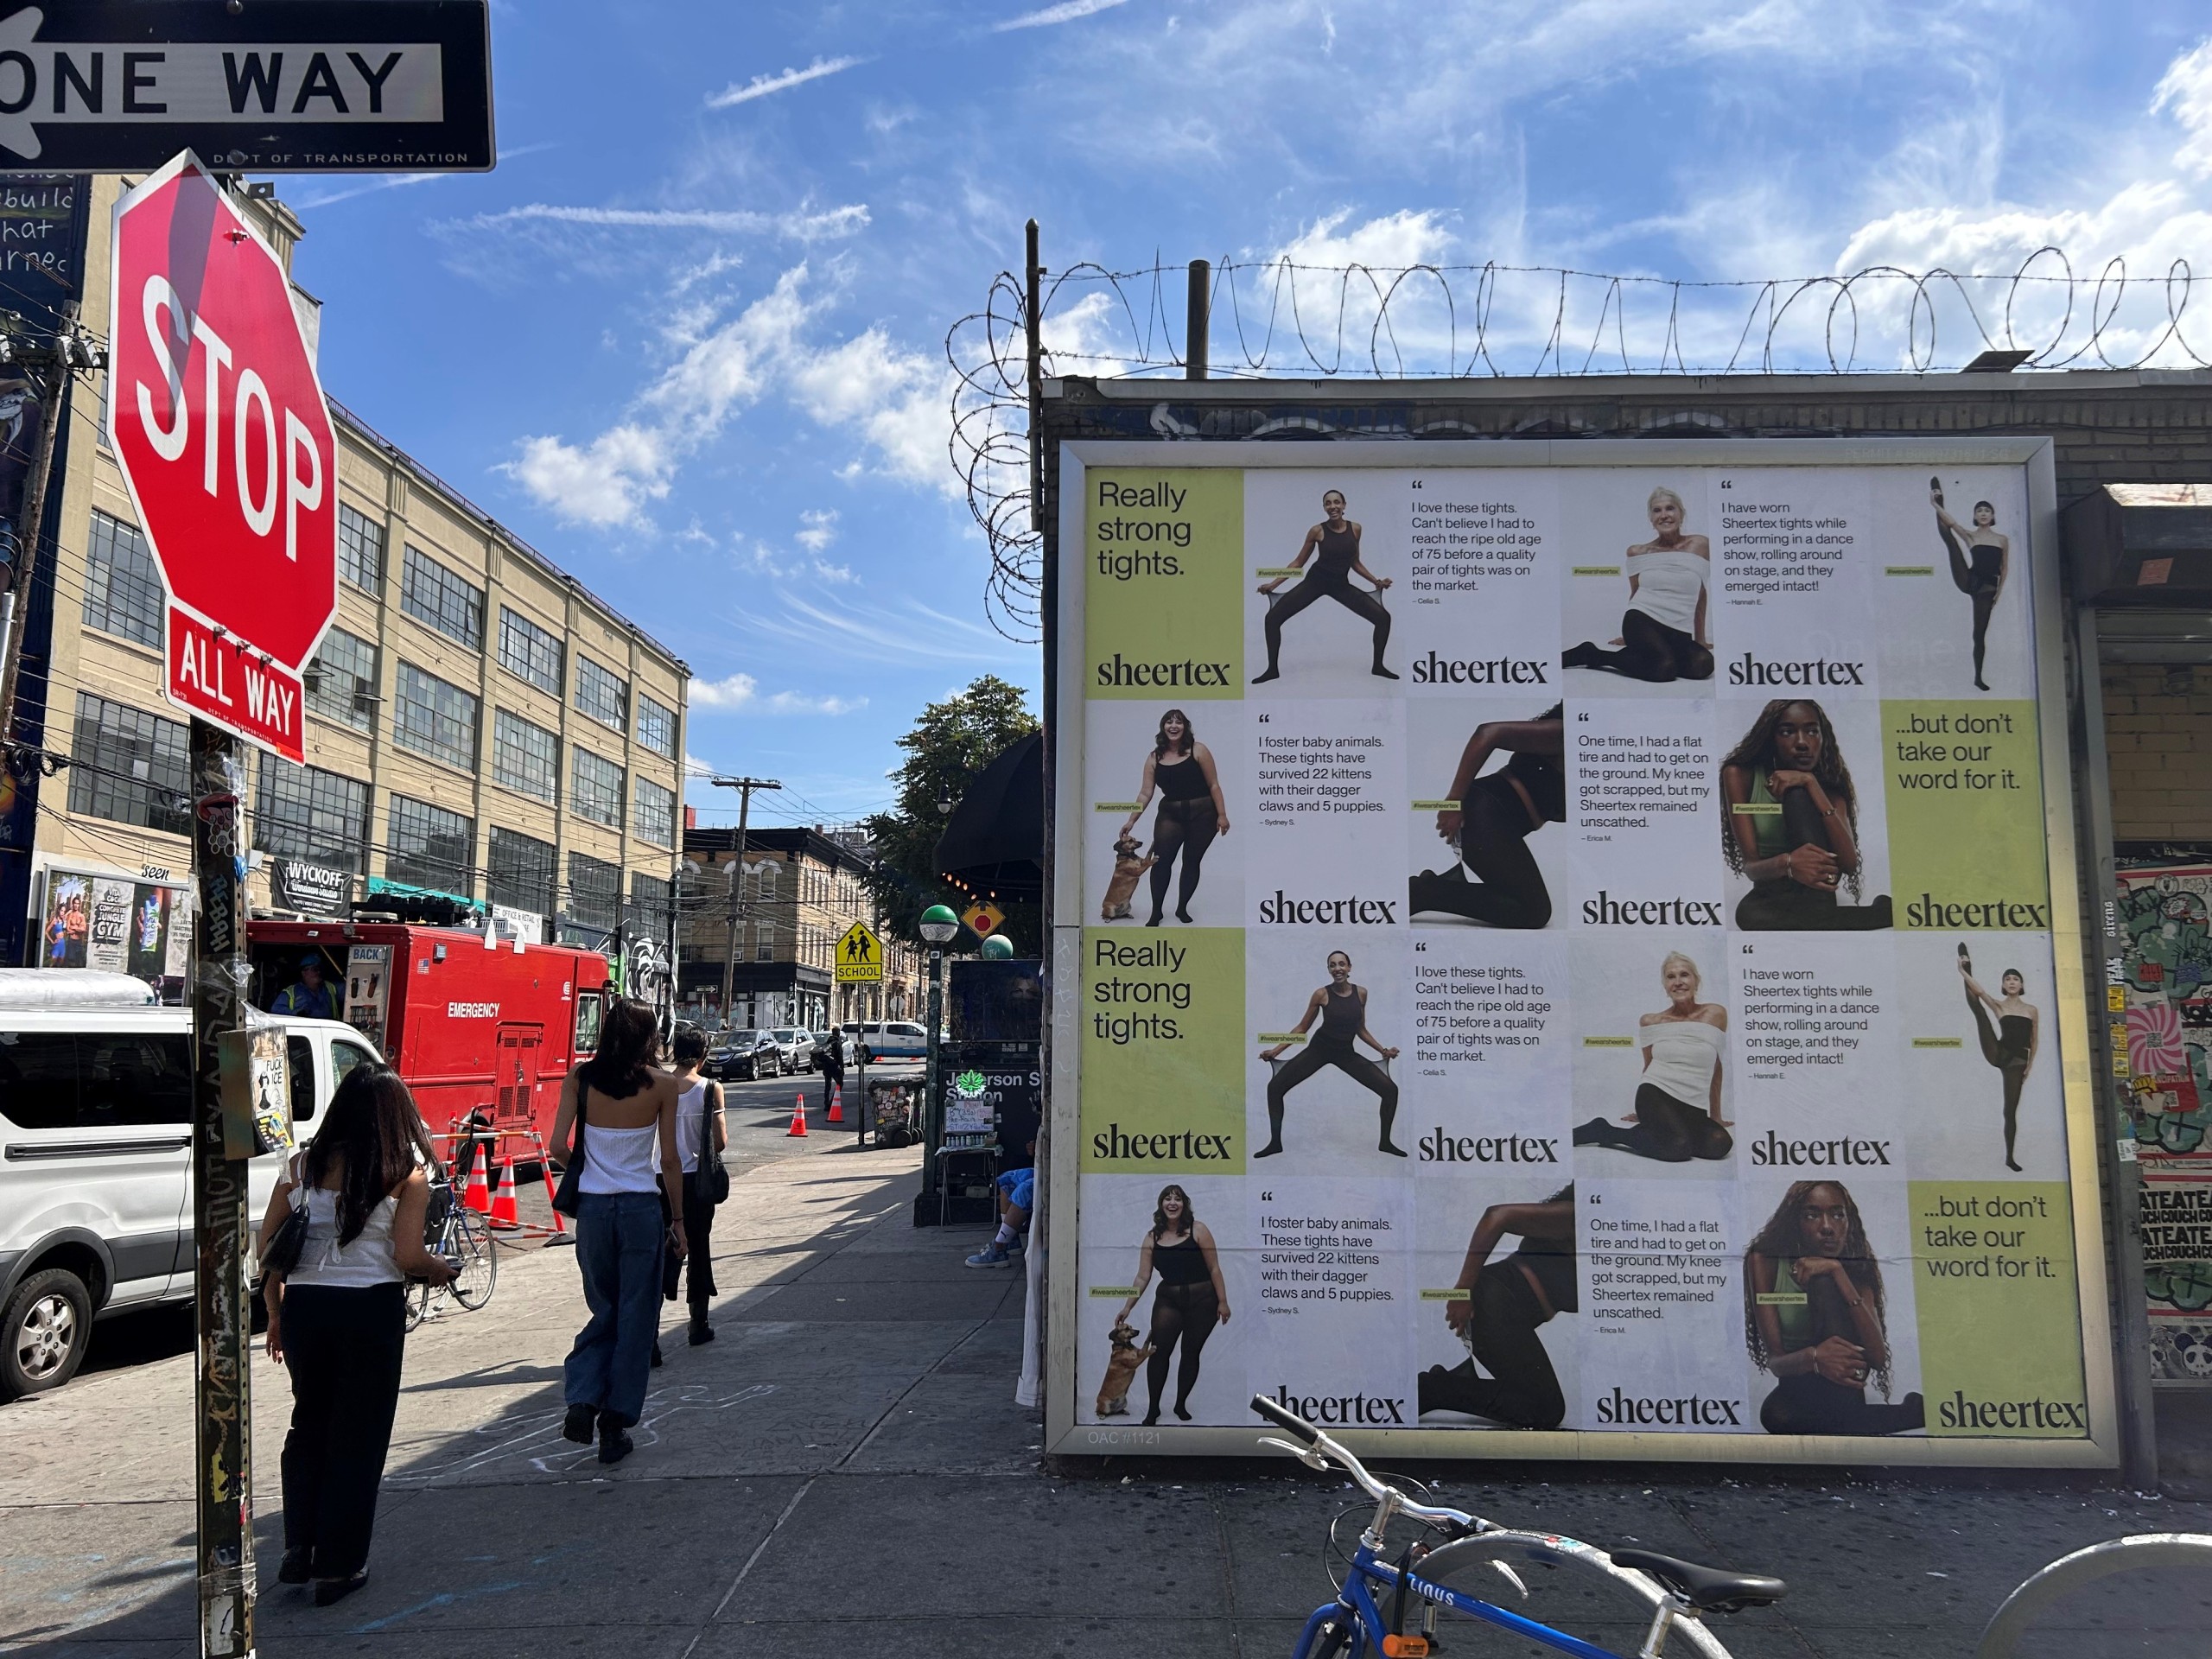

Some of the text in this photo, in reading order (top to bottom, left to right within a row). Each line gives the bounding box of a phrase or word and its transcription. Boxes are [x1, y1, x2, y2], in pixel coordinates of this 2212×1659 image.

[0, 50, 403, 114] ONE WAY
[213, 153, 468, 164] DT OF TRANSPORTATION
[0, 187, 73, 209] build
[137, 275, 322, 563] STOP
[1100, 481, 1186, 513] Really
[1412, 502, 1517, 515] I love these tights.
[1412, 518, 1535, 529] Can't believe I had to
[1097, 517, 1191, 547] strong
[1412, 533, 1541, 546] reach the ripe old age
[1412, 549, 1535, 562] of 75 before a quality
[1097, 550, 1184, 581] tights.
[1412, 564, 1530, 577] pair of tights was on
[1412, 580, 1478, 591] the market.
[1098, 653, 1230, 686] sheertex
[1413, 651, 1548, 683] sheertex
[180, 630, 295, 736] ALL WAY
[1897, 713, 2013, 734] ...but don't
[1579, 735, 1605, 747] One
[1608, 736, 1637, 747] time,
[1640, 736, 1643, 747] I
[1647, 736, 1669, 747] had
[1683, 736, 1702, 747] flat
[1897, 741, 1992, 761] take our
[1579, 752, 1599, 762] tire
[1601, 752, 1624, 762] and
[1628, 752, 1651, 763] had
[1654, 753, 1667, 763] to
[1669, 753, 1690, 766] get
[1580, 767, 1705, 781] the ground. My knee
[1898, 769, 2020, 789] word for it.
[1580, 785, 1710, 798] got scrapped, but my
[1580, 799, 1697, 811] Sheertex remained
[1580, 817, 1649, 828] unscathed.
[142, 866, 170, 881] seen
[289, 861, 342, 887] WYCKOFF
[99, 905, 126, 914] CONCRETE
[1583, 890, 1722, 925] sheertex
[1907, 893, 2046, 927] sheertex
[98, 912, 126, 924] JUNGLE
[502, 909, 518, 920] OFFICE
[522, 914, 536, 924] RETAIL
[2102, 901, 2116, 938] sirens
[98, 923, 124, 937] GYM
[353, 948, 379, 961] BACK
[838, 967, 880, 977] SCHOOL
[1743, 969, 1814, 980] I have worn
[2107, 957, 2118, 985] PEAK
[1744, 985, 1872, 999] Sheertex tights while
[448, 1001, 500, 1018] EMERGENCY
[1745, 1002, 1879, 1016] performing in a dance
[1745, 1019, 1868, 1033] show, rolling around
[1746, 1036, 1859, 1050] on stage, and they
[266, 1058, 283, 1072] FUCK
[1747, 1052, 1843, 1067] emerged intact!
[271, 1071, 283, 1084] ICE
[1751, 1130, 1891, 1166] sheertex
[1262, 1216, 1392, 1231] I foster baby animals.
[2161, 1210, 2197, 1224] COUCH
[1262, 1234, 1372, 1249] These tights have
[1262, 1251, 1379, 1265] survived 22 kittens
[2165, 1245, 2201, 1260] COUCH
[1262, 1268, 1368, 1284] with their dagger
[1262, 1286, 1394, 1302] claws and 5 puppies.
[1268, 1306, 1292, 1315] Sydney
[1089, 1431, 1160, 1445] OAC #1121
[1410, 1578, 1455, 1606] LINUS
